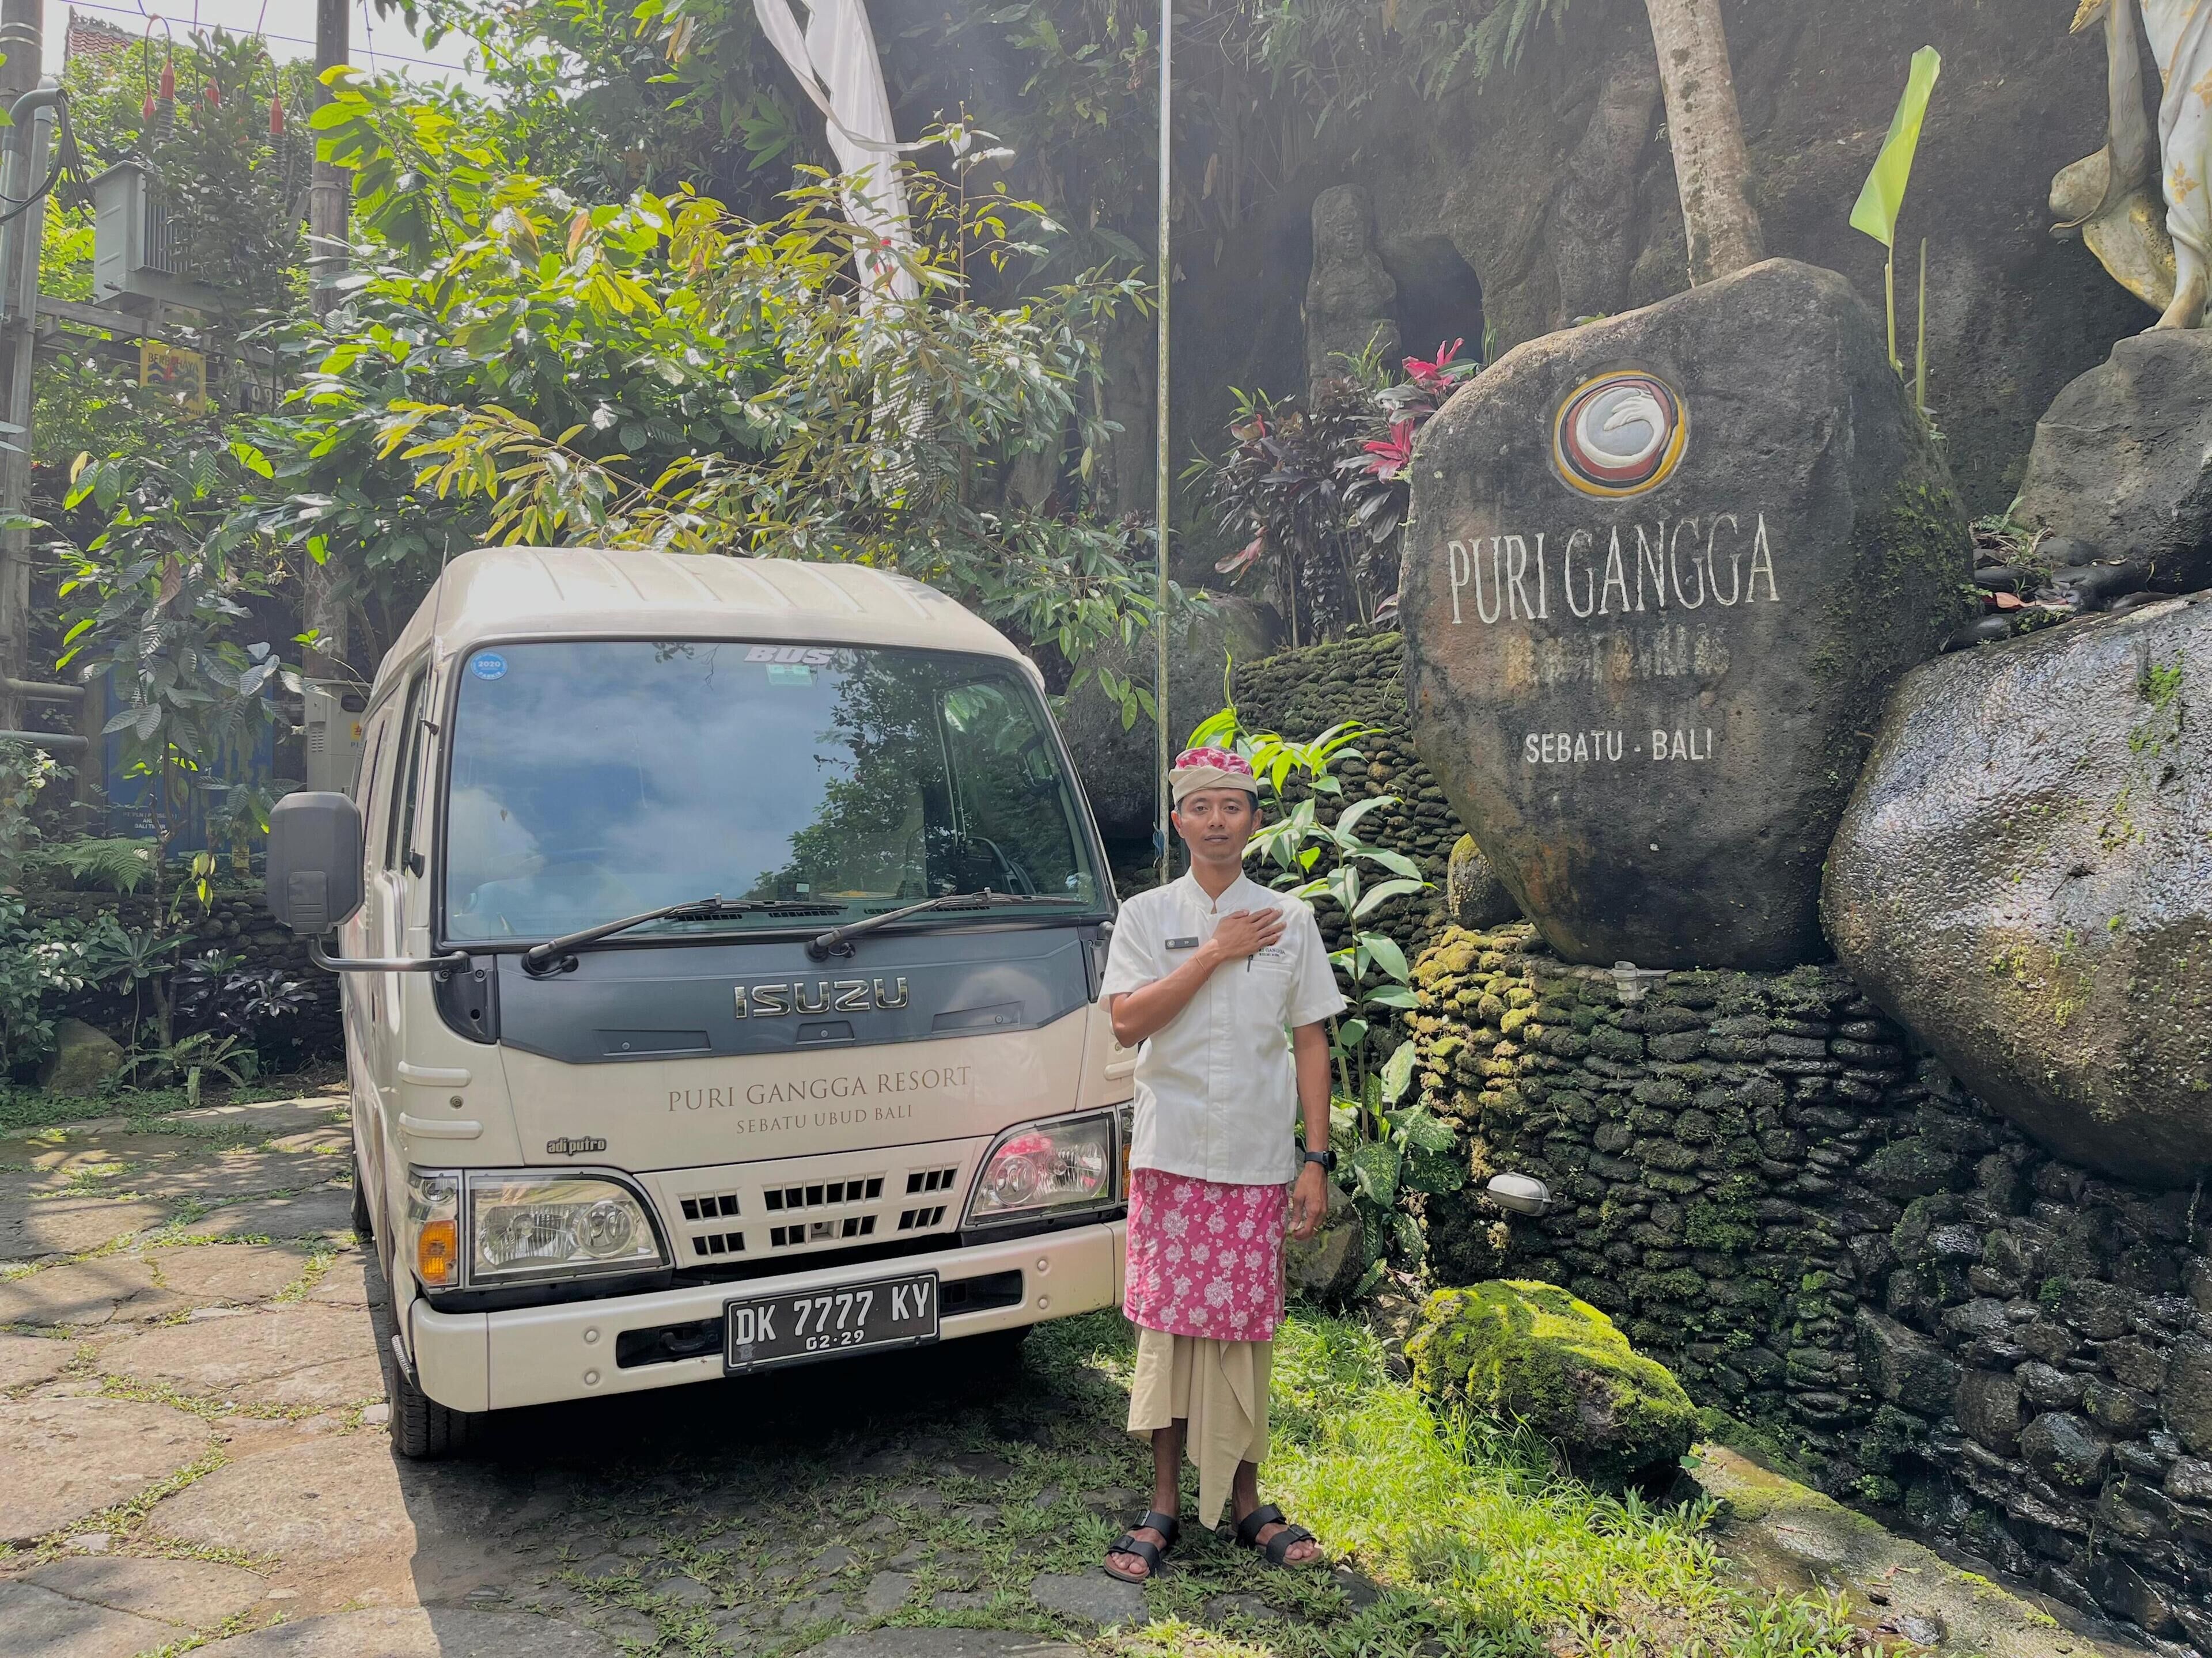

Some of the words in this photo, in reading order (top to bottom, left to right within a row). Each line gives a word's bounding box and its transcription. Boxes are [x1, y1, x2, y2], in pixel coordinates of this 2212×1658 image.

[1447, 532, 1548, 625] PURI
[1565, 512, 1780, 618] GANGGA
[744, 647, 835, 665] BUS
[1525, 729, 1623, 764] SEBATU
[1651, 727, 1713, 761] BALI
[734, 977, 908, 1019] ISUZU
[668, 1087, 735, 1112] PURI
[746, 1075, 869, 1105] GANGGA
[877, 1065, 972, 1094] RESORT
[737, 1114, 807, 1134] SEBATU
[814, 1109, 868, 1127] UBUD
[874, 1104, 913, 1121] BALI
[735, 1304, 777, 1346] DK
[793, 1290, 874, 1337] 7777
[891, 1281, 930, 1322] KY
